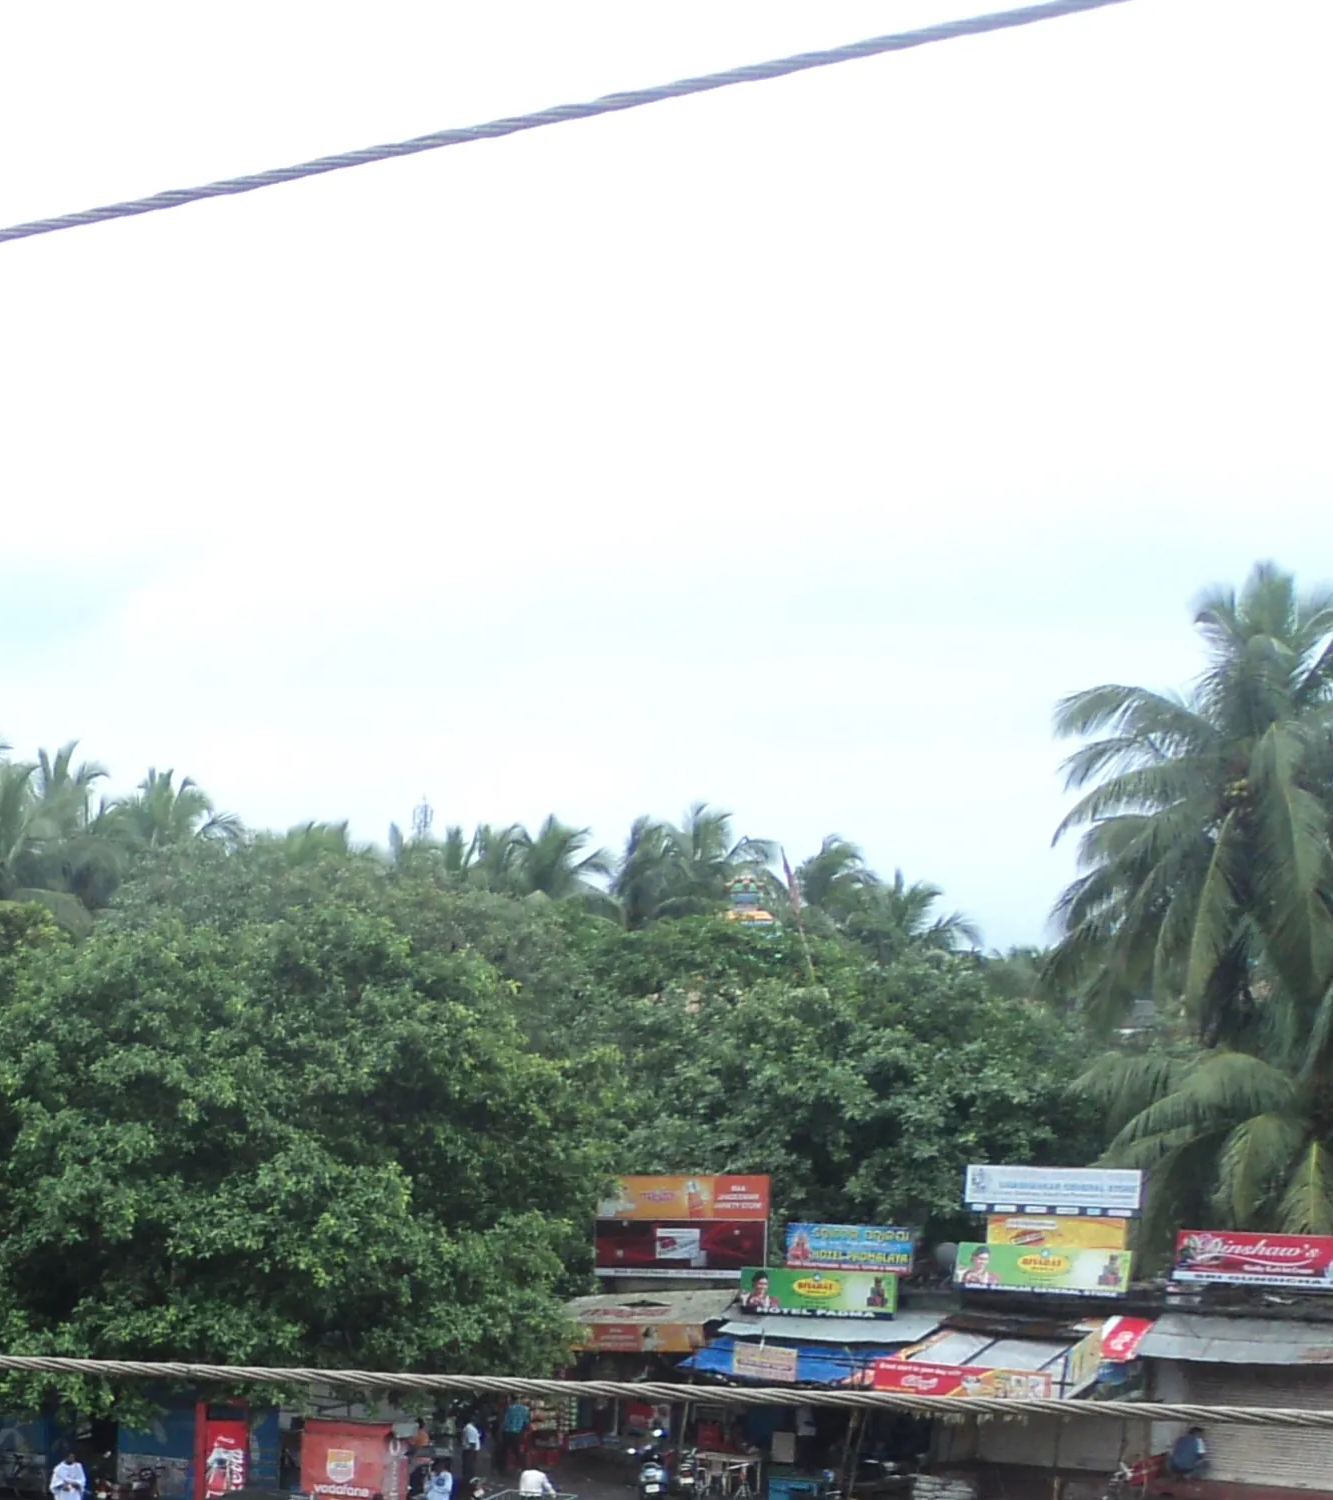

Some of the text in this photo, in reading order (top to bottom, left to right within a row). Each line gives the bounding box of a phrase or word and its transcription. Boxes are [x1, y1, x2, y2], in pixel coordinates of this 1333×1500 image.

[756, 1306, 875, 1318] HOTEL PADMA
[313, 1483, 369, 1497] vodafone
